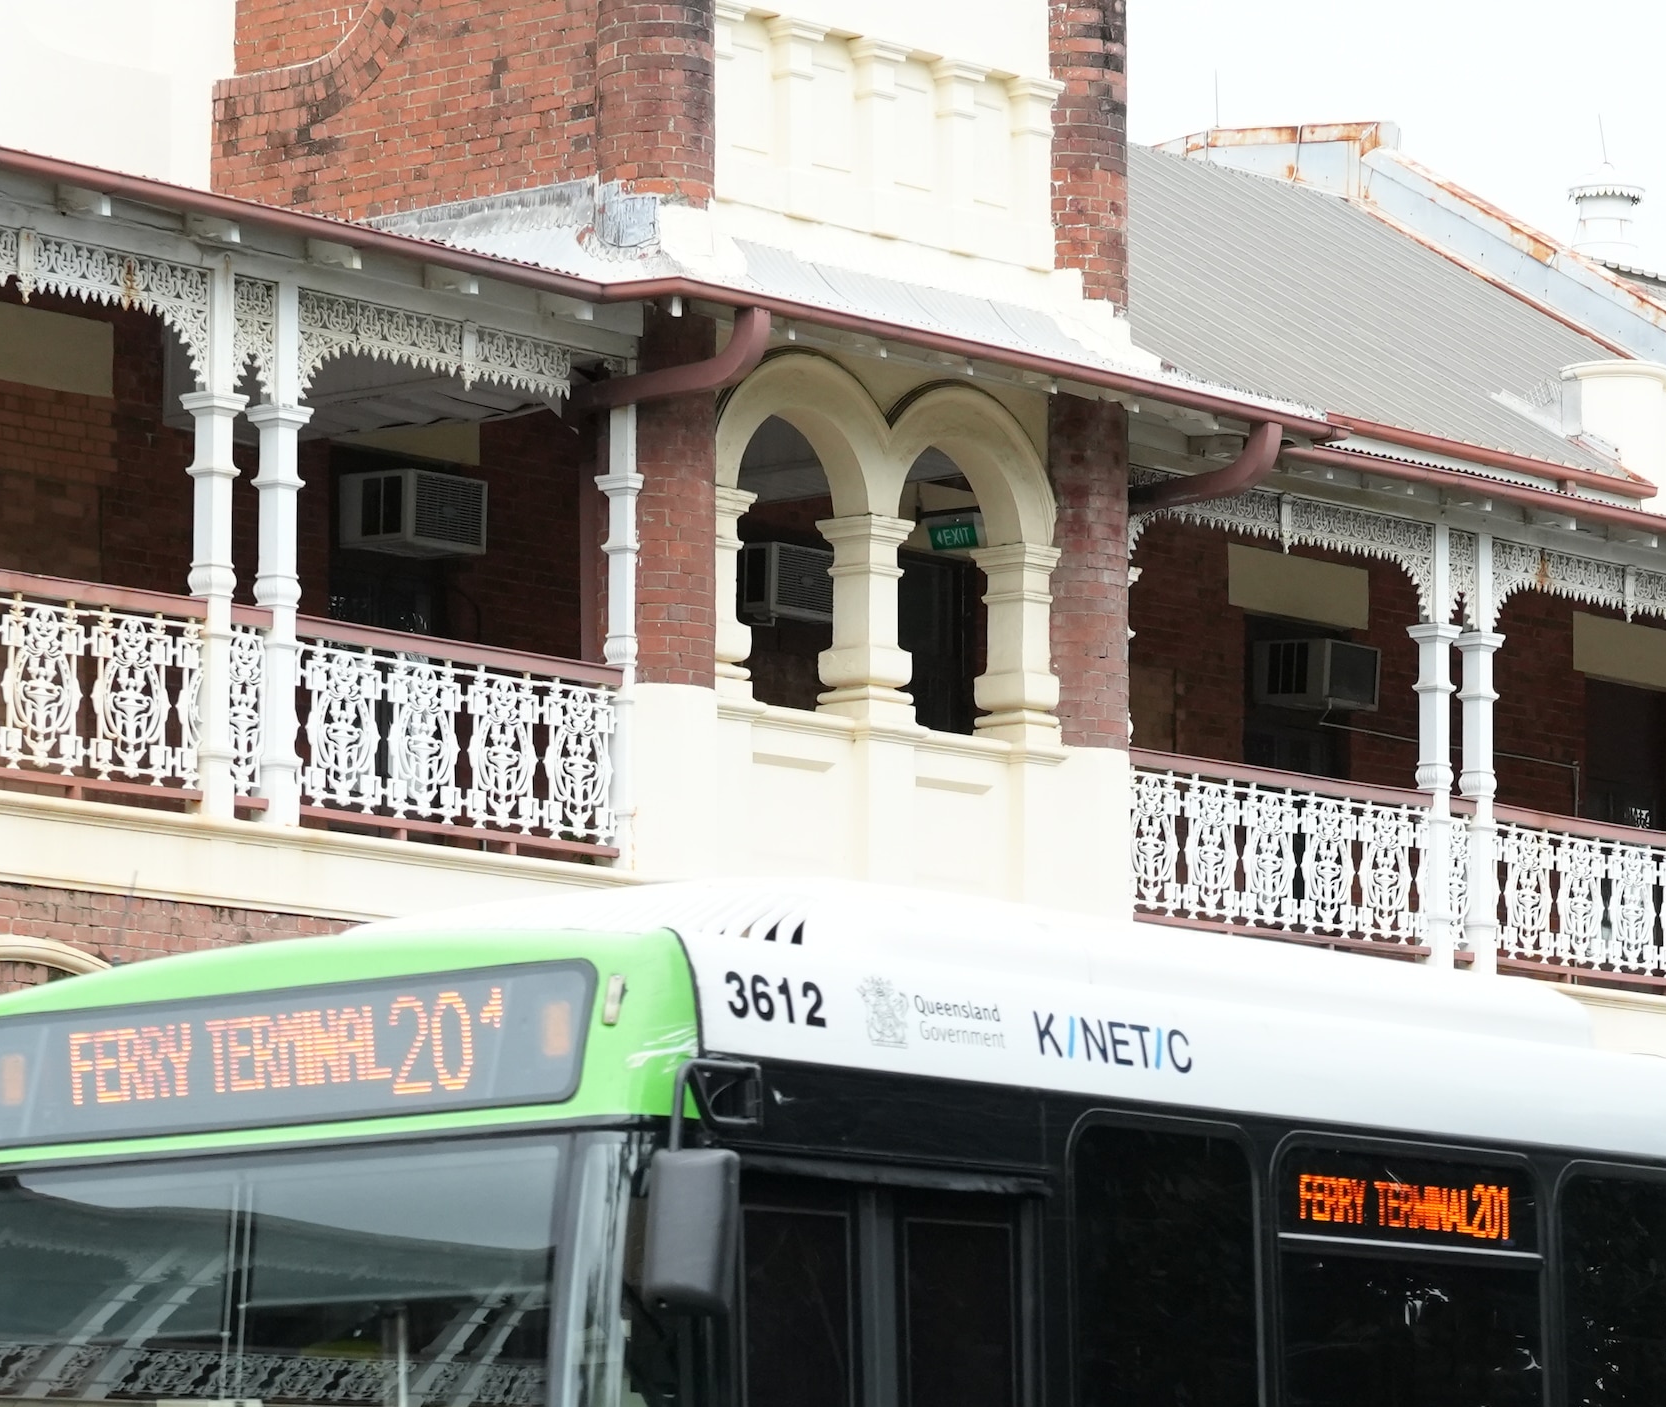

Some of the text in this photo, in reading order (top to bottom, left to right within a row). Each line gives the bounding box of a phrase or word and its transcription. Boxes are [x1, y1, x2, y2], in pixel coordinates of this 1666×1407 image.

[942, 526, 970, 546] EXIT
[725, 970, 827, 1028] 3612
[914, 994, 1001, 1022] Queensland
[69, 1022, 191, 1105] FERRY
[205, 1006, 392, 1093] TERMINAL
[919, 1020, 1006, 1049] Government
[1033, 1010, 1192, 1074] KINETIC
[1299, 1173, 1366, 1225] FERRY
[1472, 1183, 1510, 1240] 201
